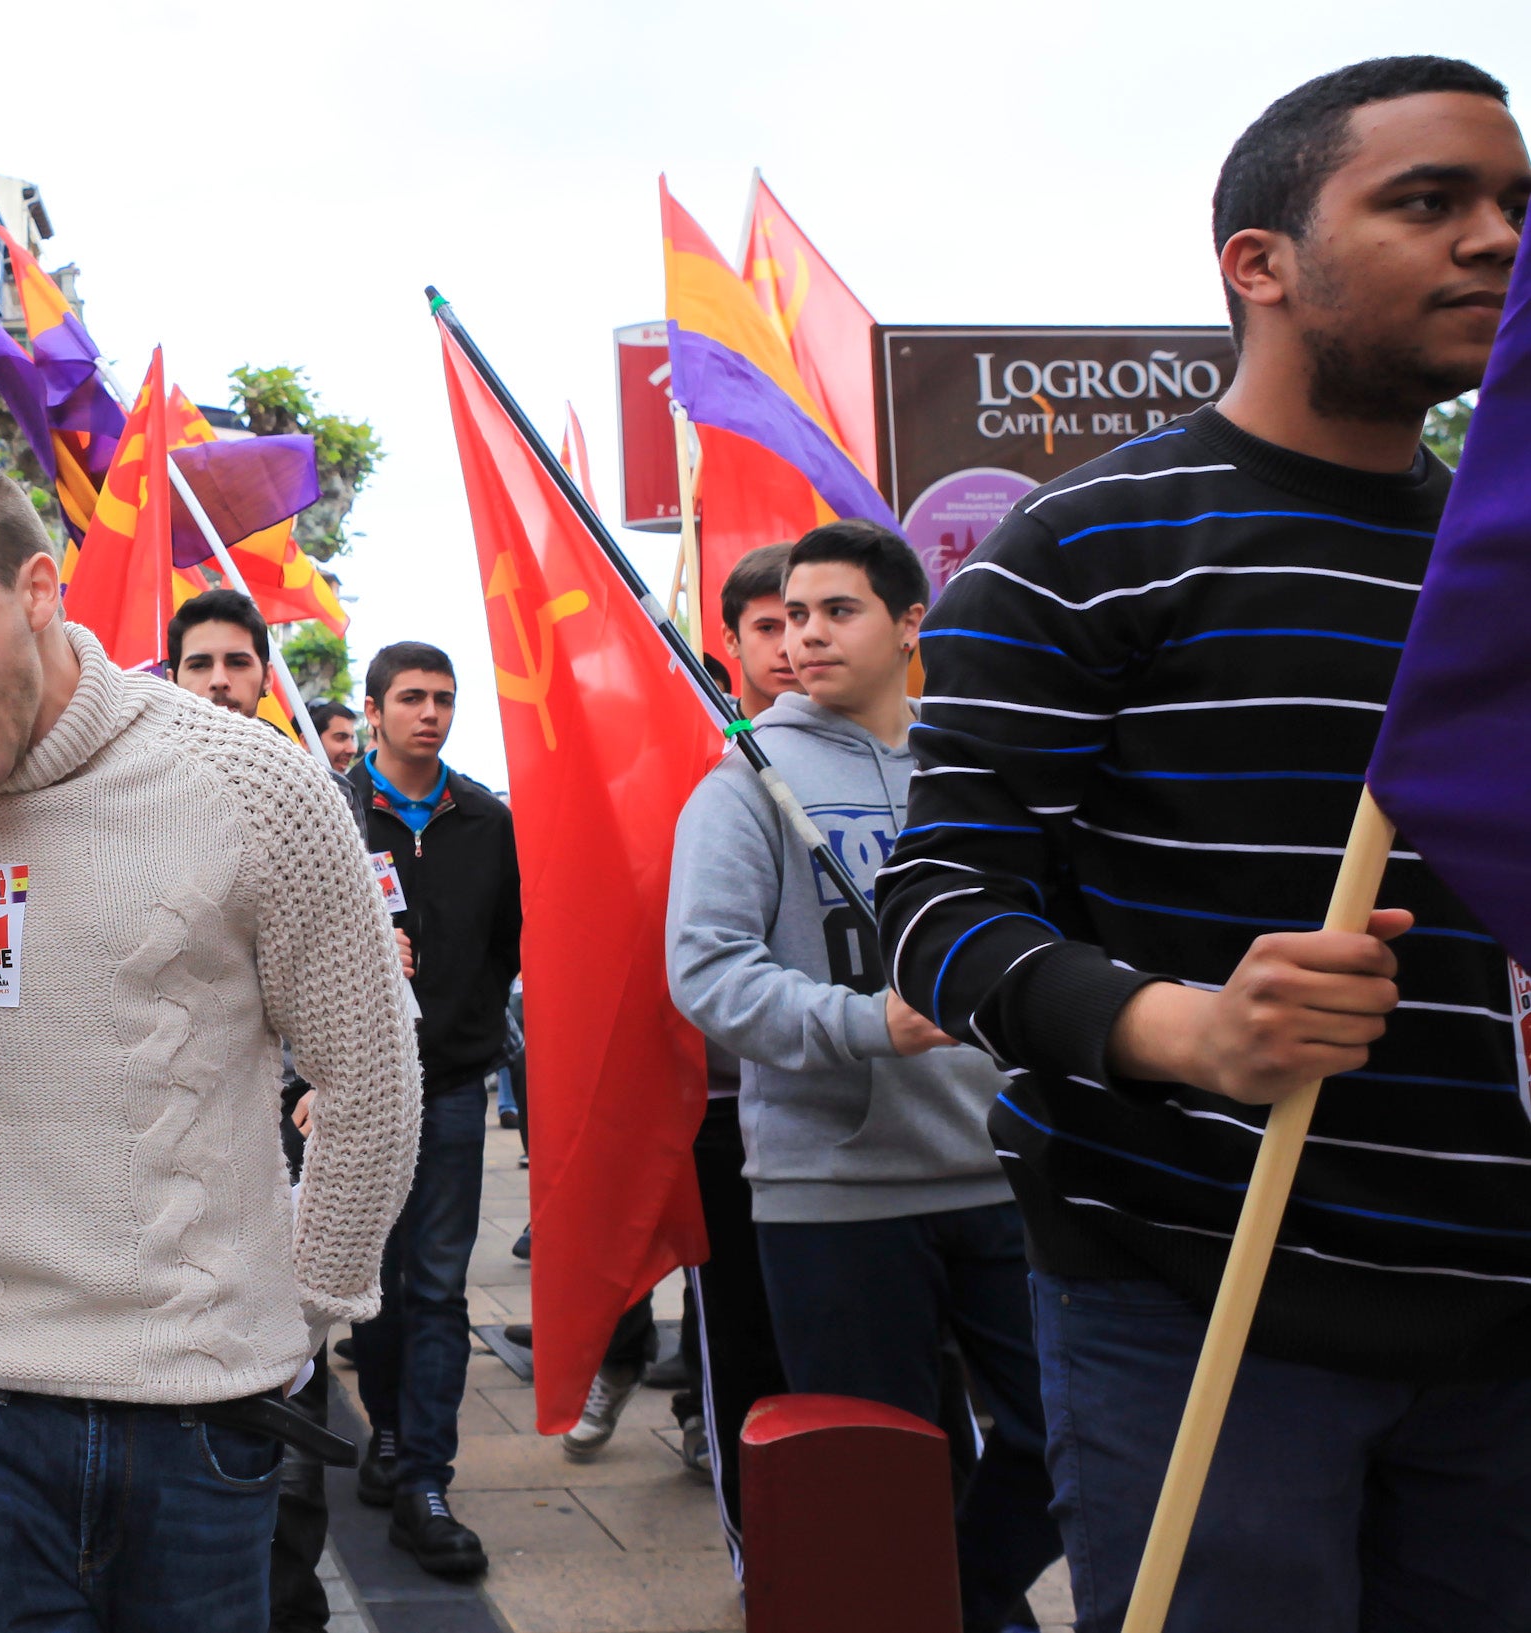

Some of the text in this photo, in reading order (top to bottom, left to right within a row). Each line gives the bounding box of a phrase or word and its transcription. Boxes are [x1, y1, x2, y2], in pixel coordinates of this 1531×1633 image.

[973, 350, 1221, 406] LOGROÑO
[977, 409, 1084, 438] CAPITAL
[1092, 413, 1138, 435] DEL
